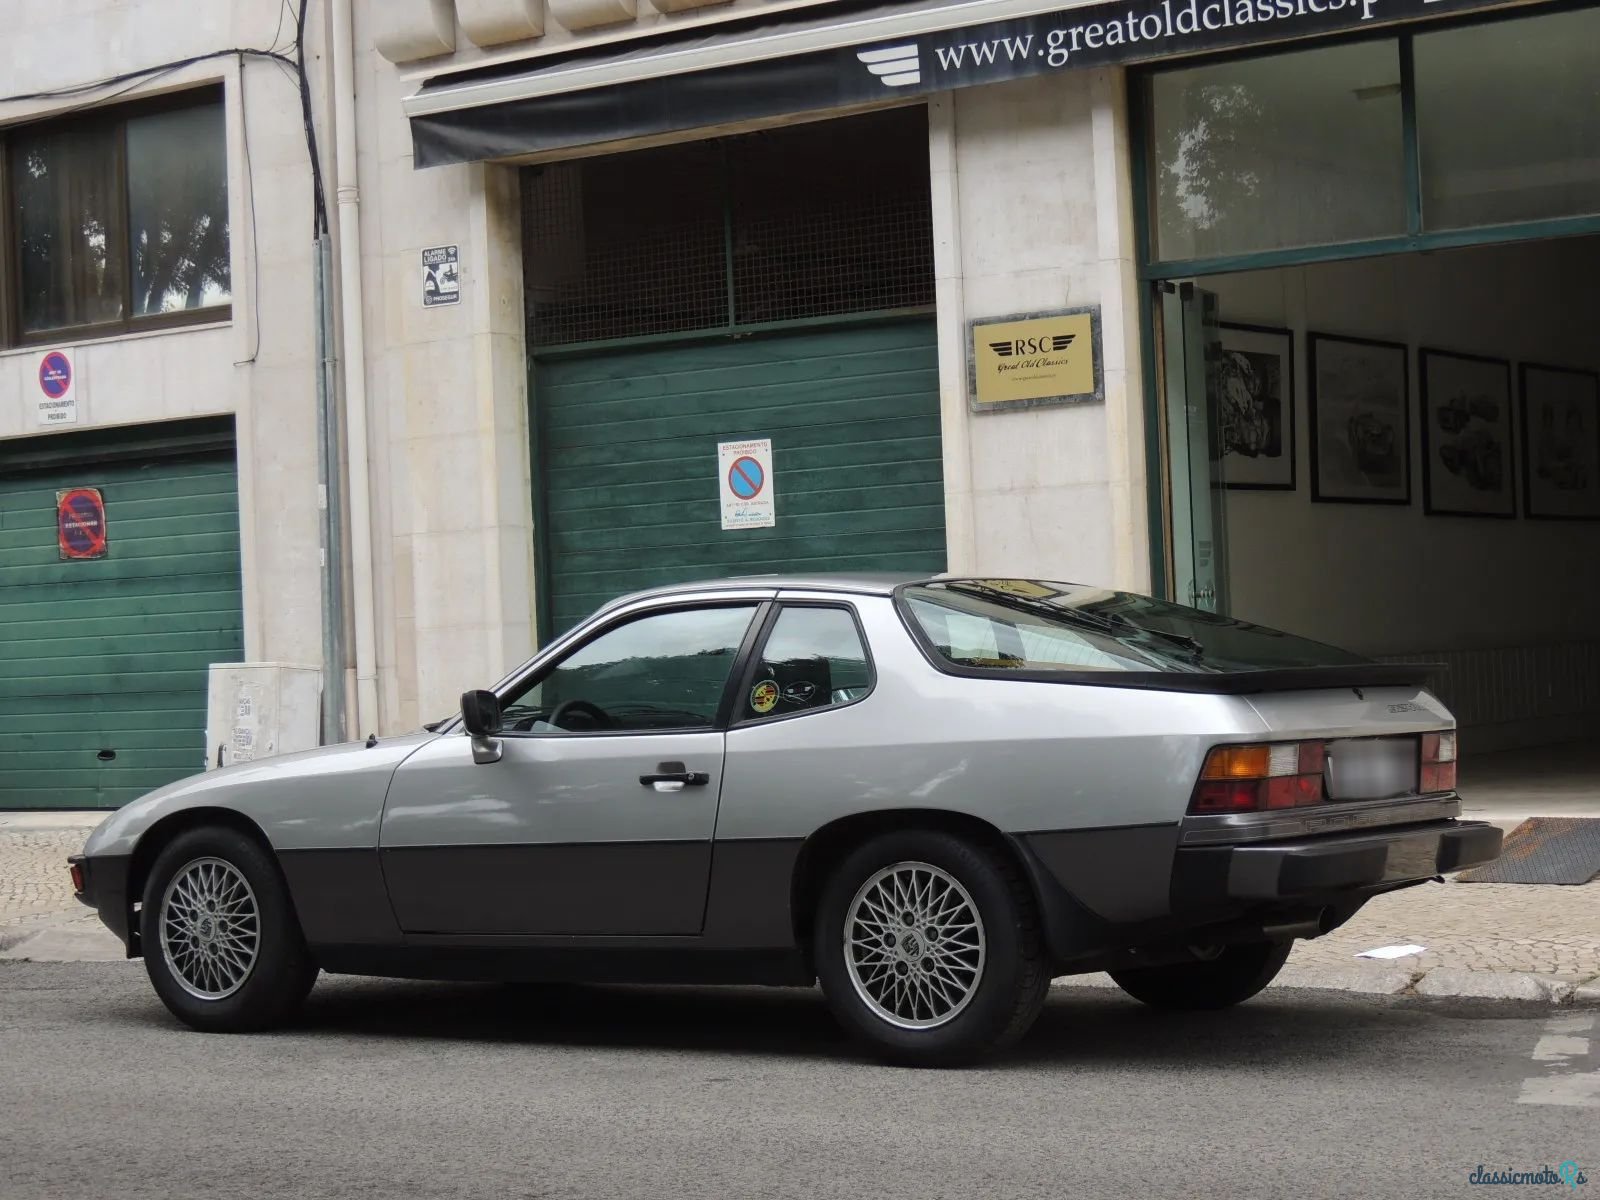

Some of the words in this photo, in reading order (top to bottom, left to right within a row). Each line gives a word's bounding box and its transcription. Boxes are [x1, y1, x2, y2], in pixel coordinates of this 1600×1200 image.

[1015, 336, 1052, 356] RSC
[997, 361, 1020, 374] Great
[1021, 359, 1037, 369] Old
[1036, 357, 1069, 368] Classics
[722, 441, 768, 451] ESTACIONAMENTO
